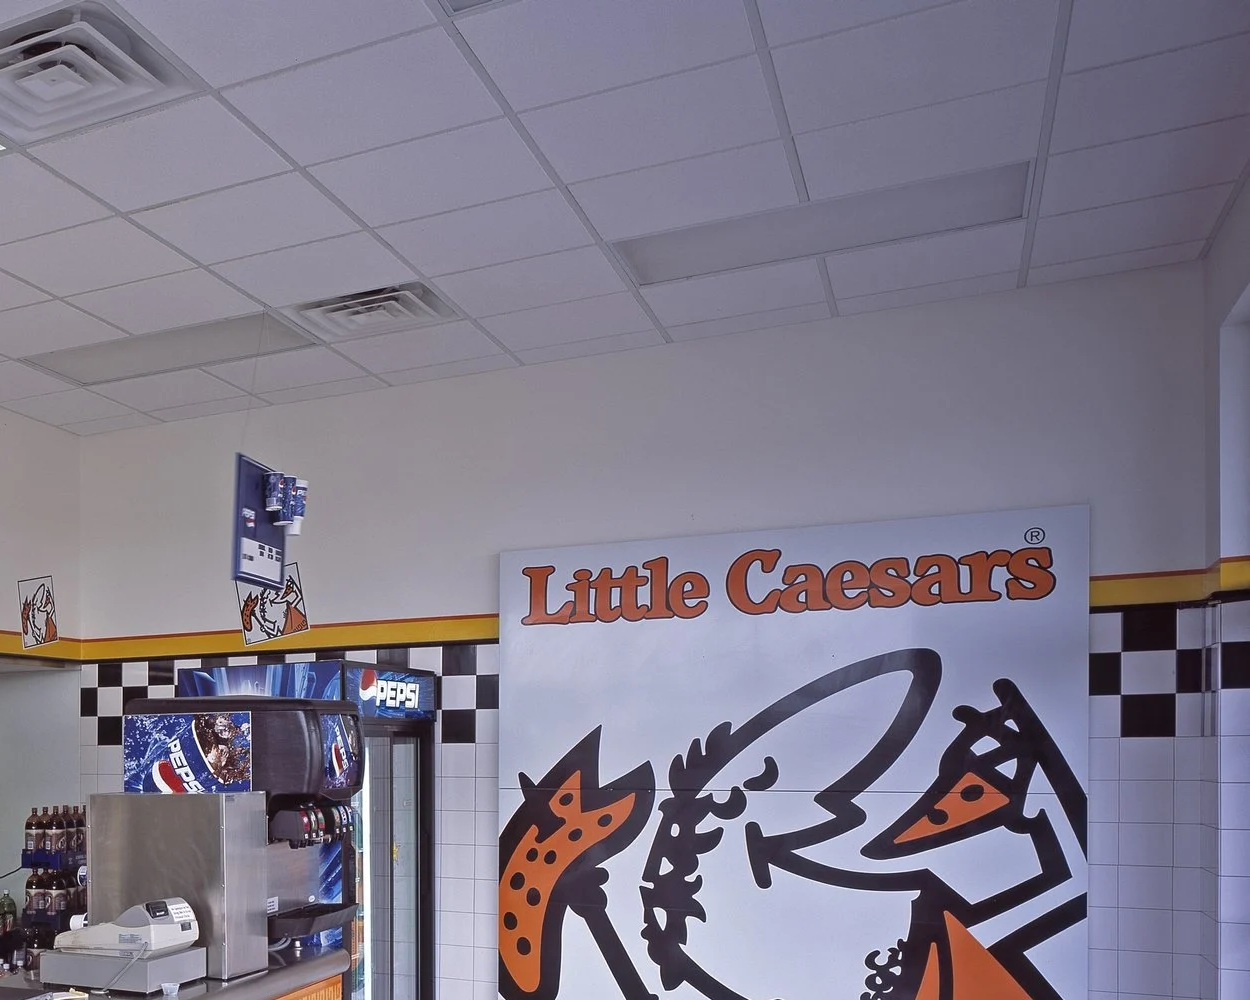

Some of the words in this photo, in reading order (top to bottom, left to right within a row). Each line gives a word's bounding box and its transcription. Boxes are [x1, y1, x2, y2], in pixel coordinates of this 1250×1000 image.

[521, 556, 710, 626] Little
[726, 547, 1056, 616] Caesars
[376, 679, 419, 708] PEPSI
